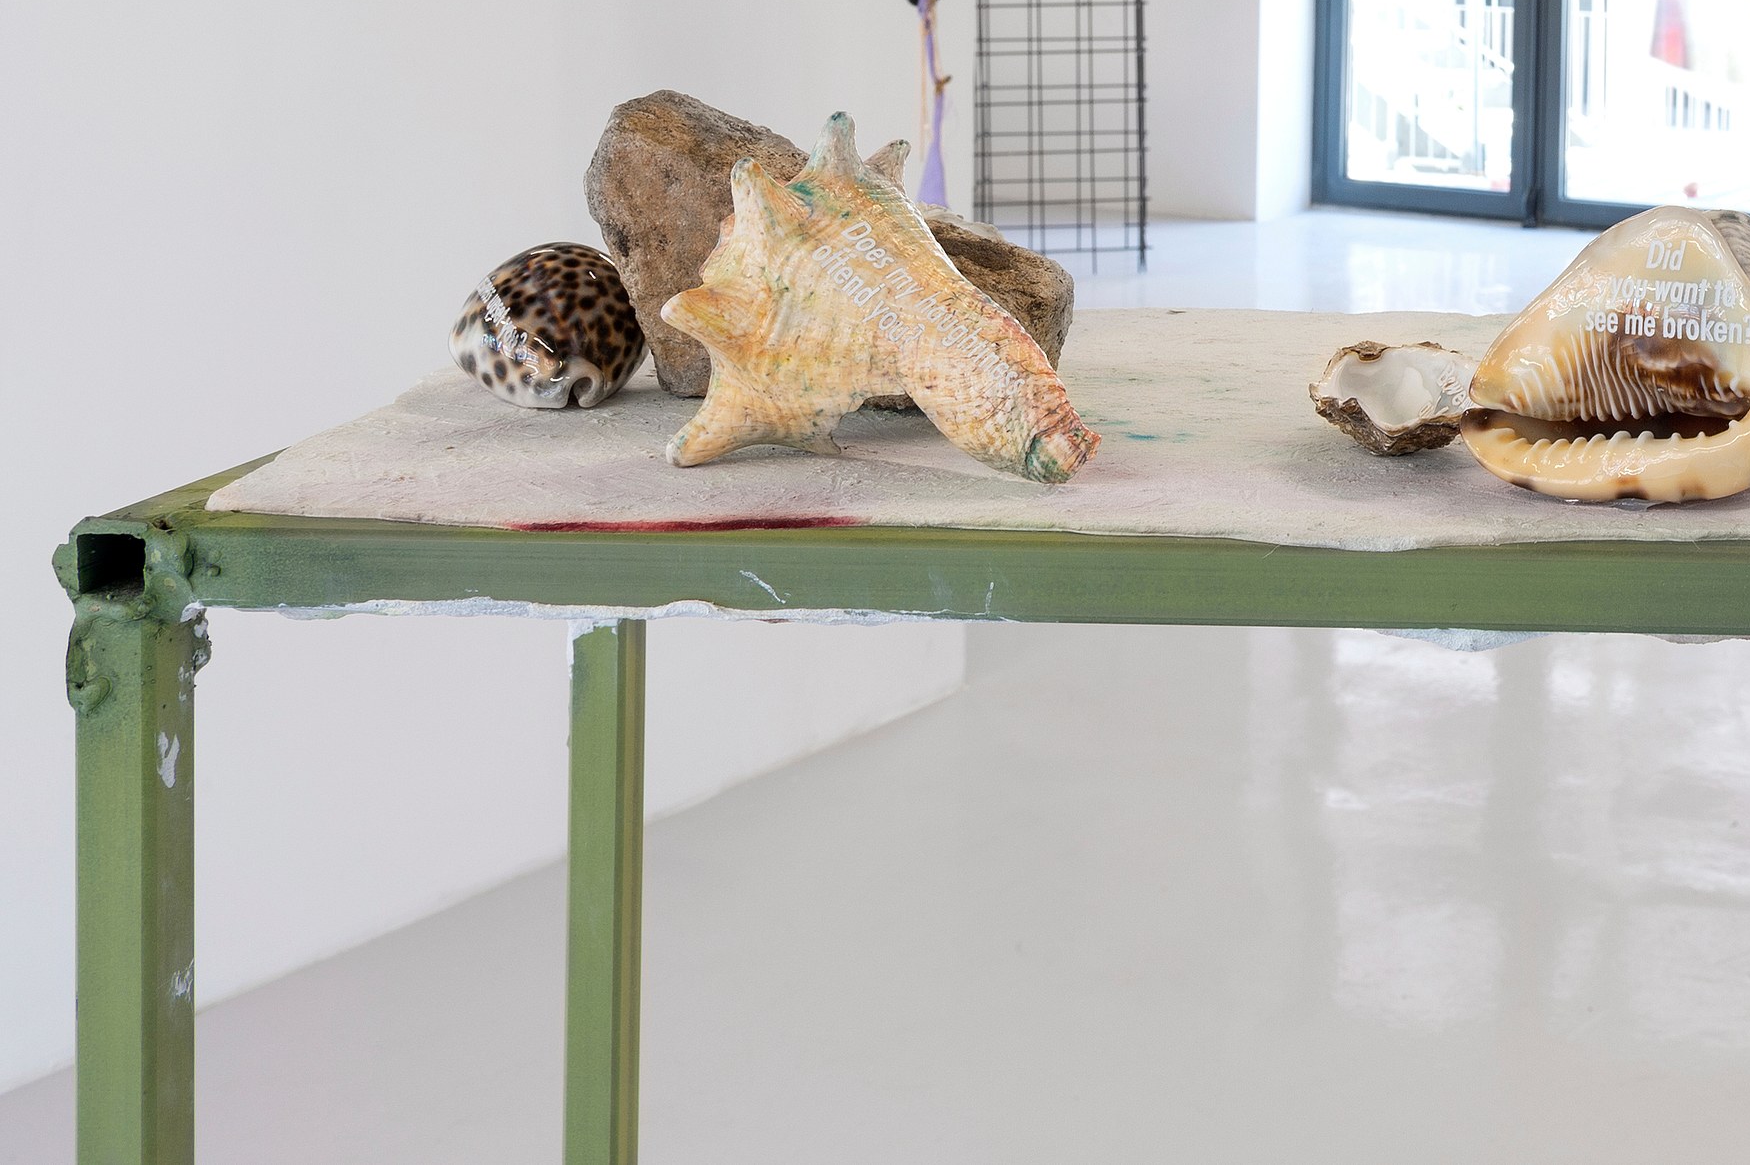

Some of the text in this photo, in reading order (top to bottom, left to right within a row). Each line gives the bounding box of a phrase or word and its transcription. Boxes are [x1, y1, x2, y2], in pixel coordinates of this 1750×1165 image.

[1646, 240, 1686, 271] Did
[811, 244, 925, 343] offend you?
[840, 221, 1025, 395] Does my haughtiness
[1610, 278, 1738, 308] you want to
[1585, 311, 1619, 333] see
[1624, 314, 1656, 337] me
